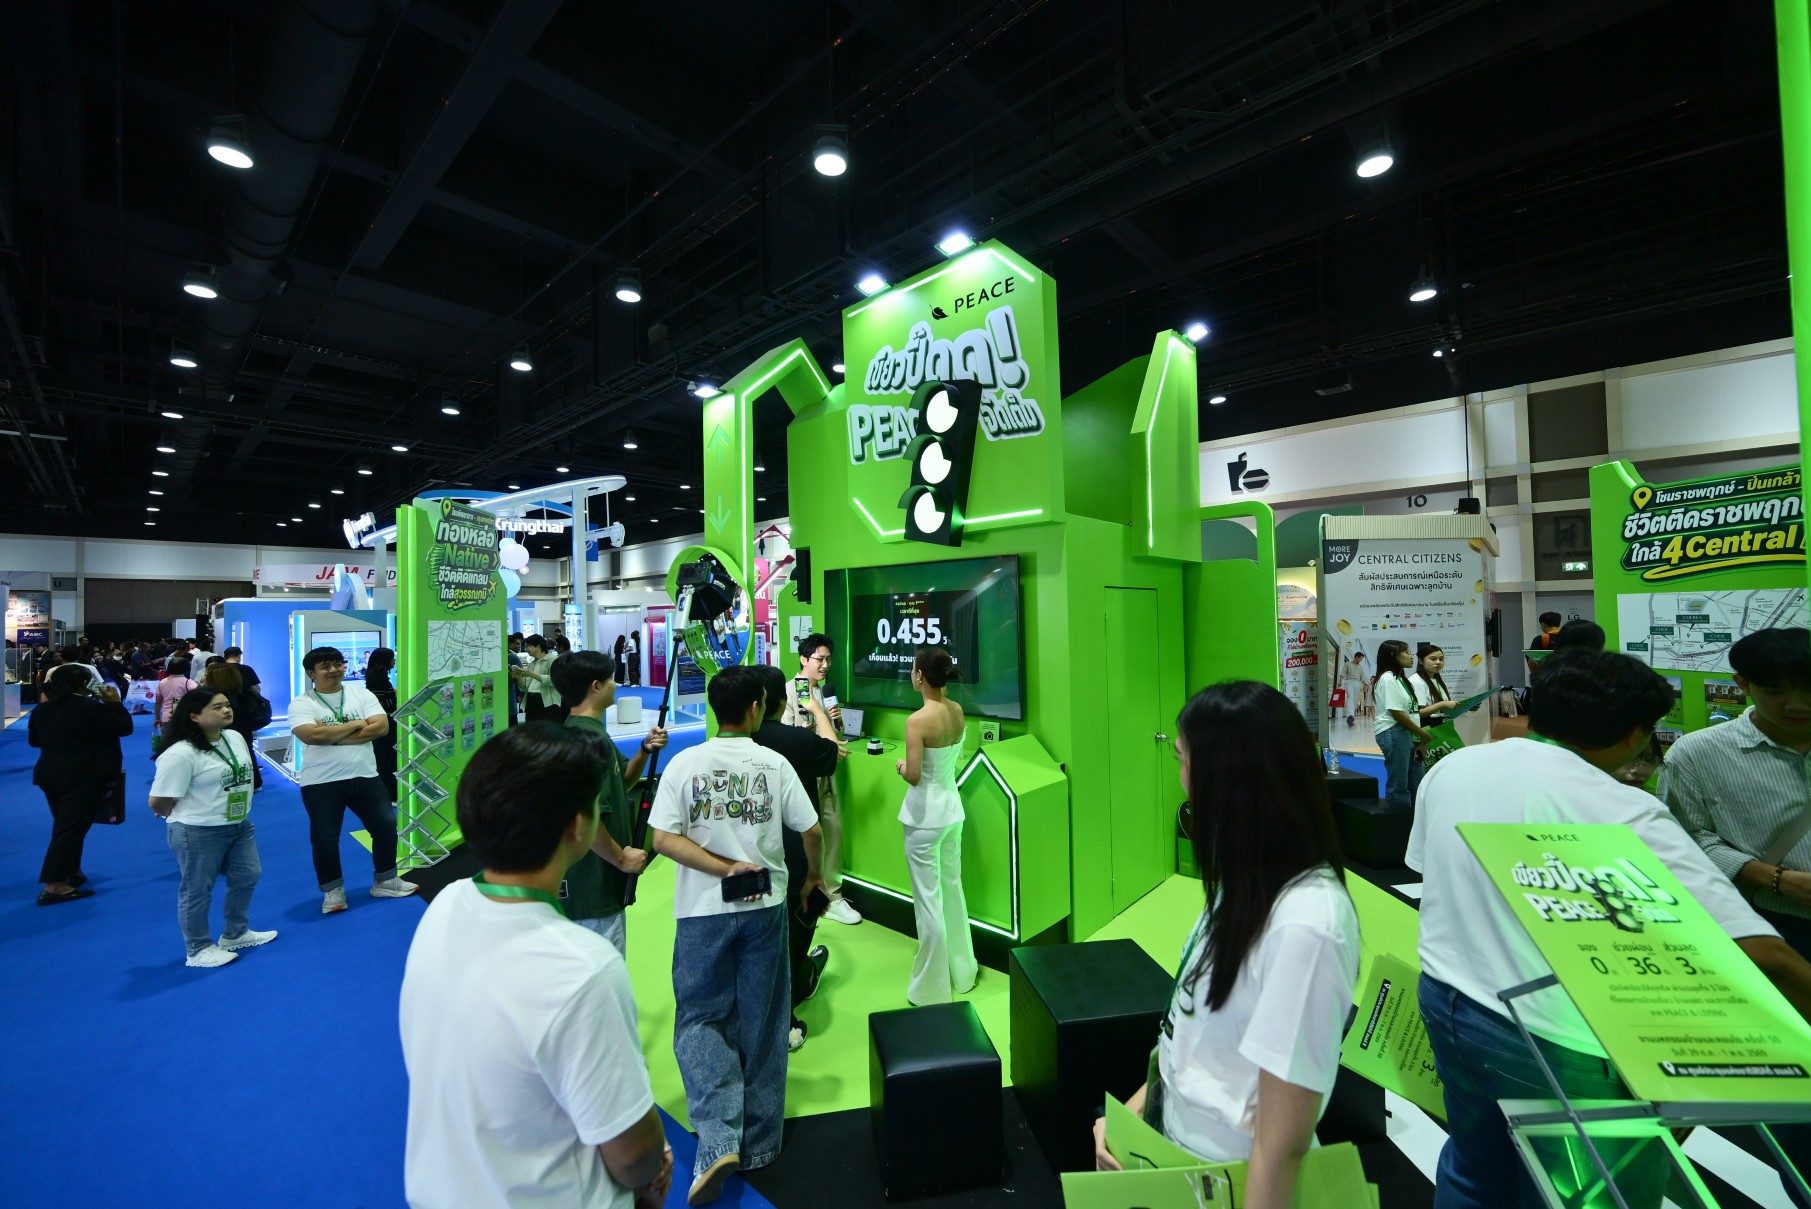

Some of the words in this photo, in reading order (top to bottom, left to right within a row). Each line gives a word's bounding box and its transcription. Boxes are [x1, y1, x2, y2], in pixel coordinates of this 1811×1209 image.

[954, 276, 1015, 313] PEACE
[849, 406, 919, 462] PEAC
[1655, 480, 1736, 503] โซนราชพฤกษ์
[1747, 471, 1801, 490] ปิ่นเกล้า
[1406, 494, 1428, 508] 10
[437, 521, 495, 548] ทองหล่อ
[1328, 545, 1350, 553] MORE
[1686, 525, 1798, 560] Central
[444, 543, 490, 569] Native
[1329, 554, 1350, 563] JOY
[1358, 554, 1409, 565] CENTRAL
[1412, 553, 1462, 564] CITIZENS
[1358, 571, 1463, 581] สัมผัสประสบการณ์เหนือระดับ
[1370, 582, 1453, 592] สิทธิพิเศษเฉพาะลูกบ้าน
[877, 617, 942, 645] 0.455
[703, 649, 730, 659] PEACE
[868, 652, 899, 662] เกือบแล้ว!
[1541, 834, 1580, 842] PEACE
[1591, 957, 1609, 975] 0
[1627, 957, 1662, 975] 36
[1675, 957, 1697, 975] 3
[1422, 1060, 1435, 1072] 3
